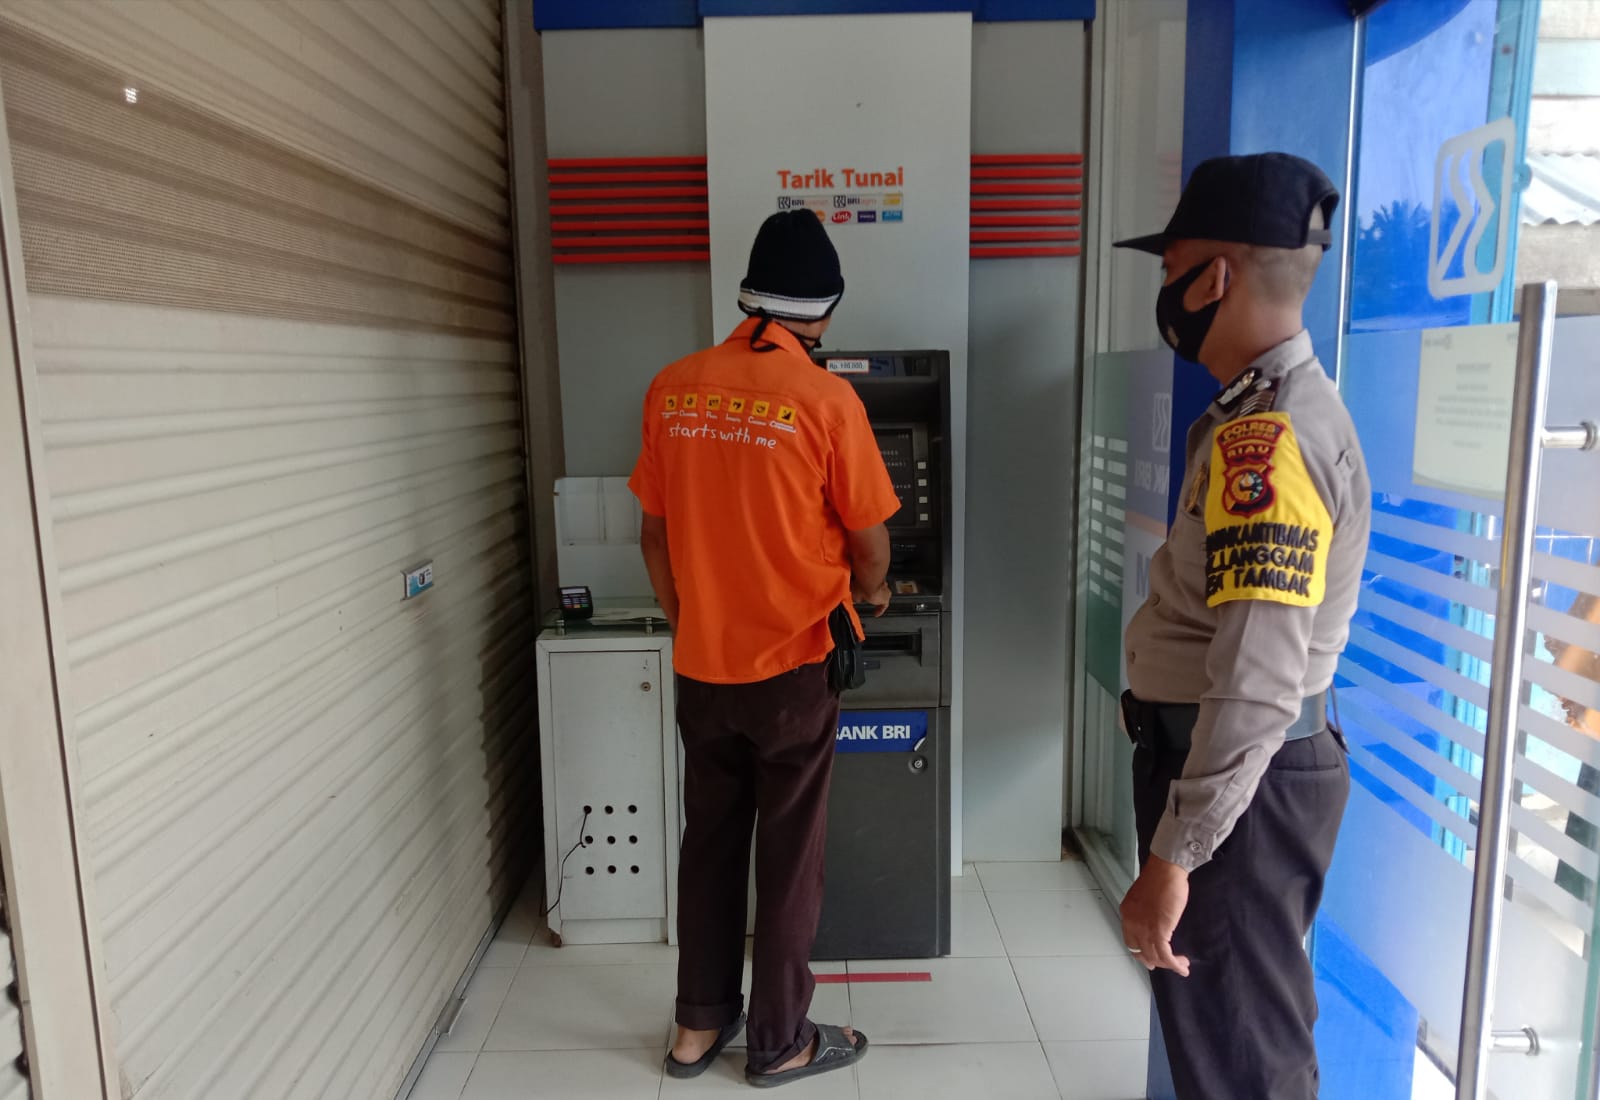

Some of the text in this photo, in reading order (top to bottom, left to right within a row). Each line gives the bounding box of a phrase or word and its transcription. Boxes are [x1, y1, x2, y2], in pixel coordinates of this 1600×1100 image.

[777, 166, 904, 189] Tarik Tunai
[669, 423, 717, 439] starts
[719, 426, 751, 444] with
[755, 436, 777, 449] me
[1227, 445, 1270, 459] RIAU
[1234, 566, 1312, 599] TAMBAK
[882, 725, 911, 739] BRI
